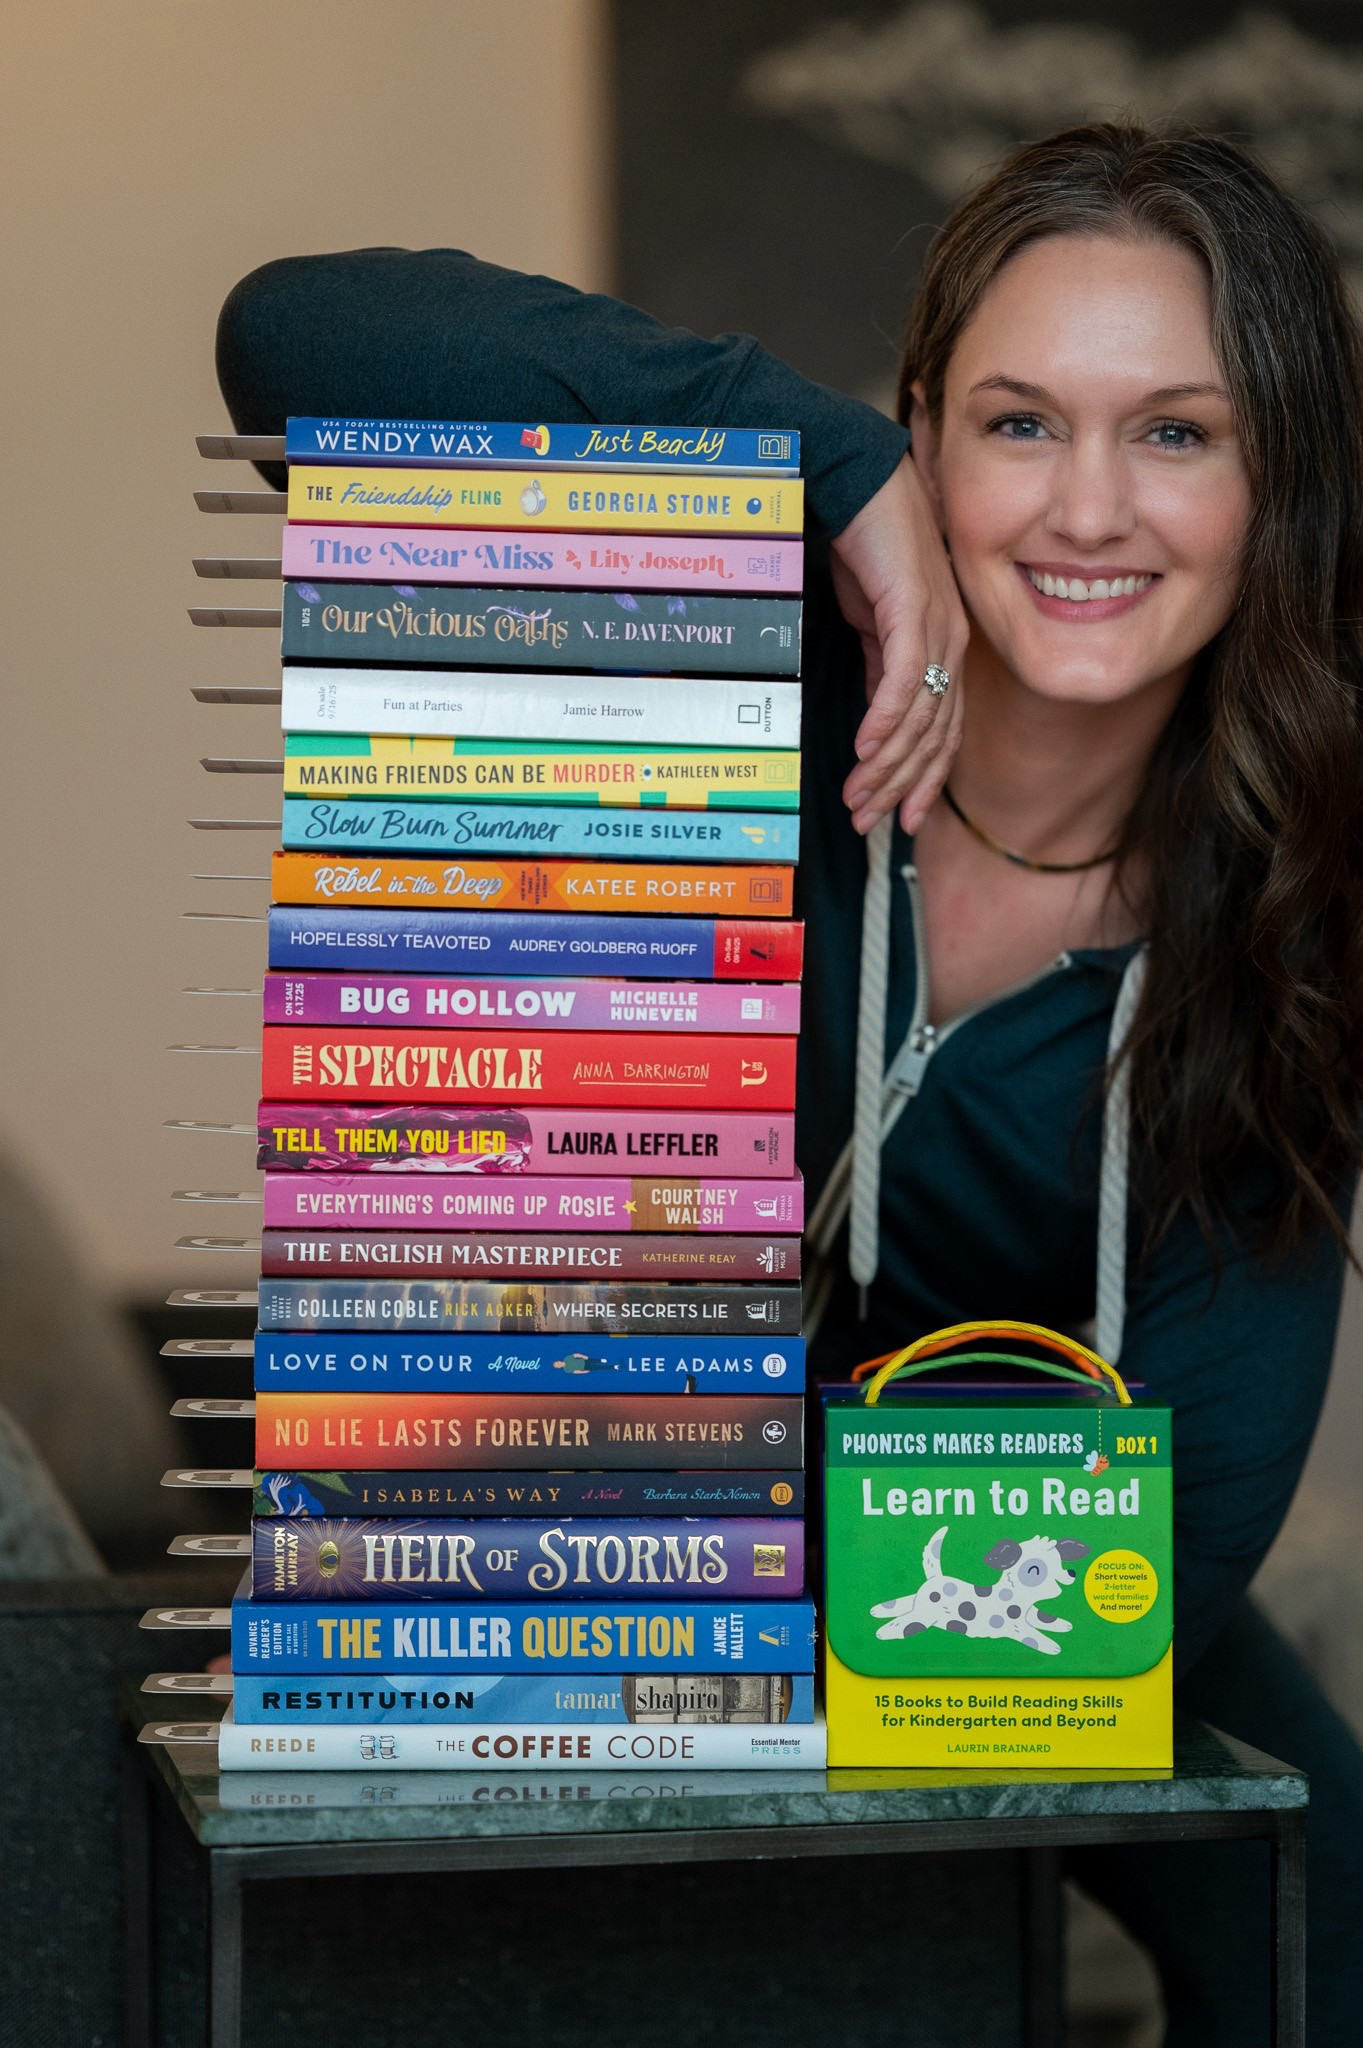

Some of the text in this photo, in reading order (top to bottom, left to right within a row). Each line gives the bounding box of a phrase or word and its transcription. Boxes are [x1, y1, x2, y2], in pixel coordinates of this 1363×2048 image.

[316, 430, 493, 455] WENDY WAX
[575, 430, 633, 457] Just
[639, 428, 726, 461] Beachy
[307, 482, 501, 515] THE Friendship FLING
[568, 491, 730, 515] GEORGIA STONE
[310, 540, 554, 570] The Near Miss
[590, 549, 734, 579] Lily Joseph
[302, 608, 310, 627] 10/25
[322, 601, 569, 649] Our Vicious Oaths
[583, 621, 735, 644] N. E. DAVENPORT
[383, 699, 463, 712] Fun at Parties
[563, 704, 644, 717] Jamie Harrow
[300, 764, 635, 785] MAKING FRIENDS CAN BE MURDER
[657, 765, 758, 778] KATHLEEN WEST
[305, 804, 563, 843] Slow Burn Summer
[584, 823, 722, 840] JOSIE SILVER
[566, 879, 736, 897] KATEE ROBERT
[291, 932, 491, 950] HOPELESSLY TEAVOTED
[509, 939, 697, 955] AUDREY GOLDBERG RUOFF
[295, 983, 304, 1016] 6.17.25
[340, 987, 576, 1017] BUG HOLLOW
[610, 991, 698, 1005] MICHELLE
[285, 1002, 293, 1016] ON
[611, 1007, 697, 1022] HUNEVEN
[293, 1044, 542, 1090] THE SPECTACLE
[573, 1062, 710, 1080] ANNA BARRINGTON
[273, 1128, 506, 1154] TELL THEM YOU LIED
[548, 1132, 718, 1156] LAURA LEFFLER
[297, 1193, 615, 1217] EVERYTHING'S COMING UP ROSIE
[651, 1189, 738, 1206] COURTNEY
[666, 1207, 723, 1225] WALSH
[284, 1242, 622, 1266] THE ENGLISH MASTERPIECE
[642, 1253, 737, 1263] KATHERINE REAY
[299, 1299, 439, 1318] COLLEEN COBLE
[445, 1303, 533, 1317] RICK ACKER
[553, 1303, 728, 1318] WHERE SECRETS LIE
[269, 1354, 472, 1372] LOVE ON TOUR
[628, 1357, 753, 1373] LEE ADAMS
[275, 1418, 590, 1447] NO LIE LASTS FOREVER
[608, 1423, 744, 1442] MARK STEVENS
[842, 1433, 1083, 1455] PHONICS MAKES READERS
[1116, 1437, 1157, 1454] BOX 1
[363, 1488, 560, 1503] ISABELA'S WAY
[643, 1488, 761, 1500] Barbara Stark-Nemon
[862, 1478, 1140, 1516] Learn to Read
[275, 1527, 285, 1592] HAMILTON
[287, 1532, 298, 1585] MURRAY
[362, 1527, 728, 1592] HEIR OF STORMS
[1104, 1583, 1136, 1591] 2-letter
[1116, 1593, 1149, 1601] families
[249, 1621, 258, 1658] ADVANCE
[261, 1619, 269, 1659] READER'S
[274, 1622, 282, 1655] EDITION
[317, 1616, 694, 1659] THE KILLER QUESTION
[713, 1617, 726, 1656] JANICE
[730, 1613, 743, 1659] HALLETT
[262, 1692, 474, 1710] RESTITUTION
[554, 1686, 718, 1716] tamar shapiro
[875, 1695, 1123, 1711] 15 Books to Build Reading Skills
[882, 1714, 1116, 1730] for Kindergarten and Beyond
[251, 1738, 315, 1752] REEDE
[436, 1735, 694, 1759] THE COFFEE CODE
[751, 1738, 801, 1746] Essential Mentor
[751, 1746, 801, 1754] PRESS
[947, 1744, 1051, 1753] LAURIN BRAINARD
